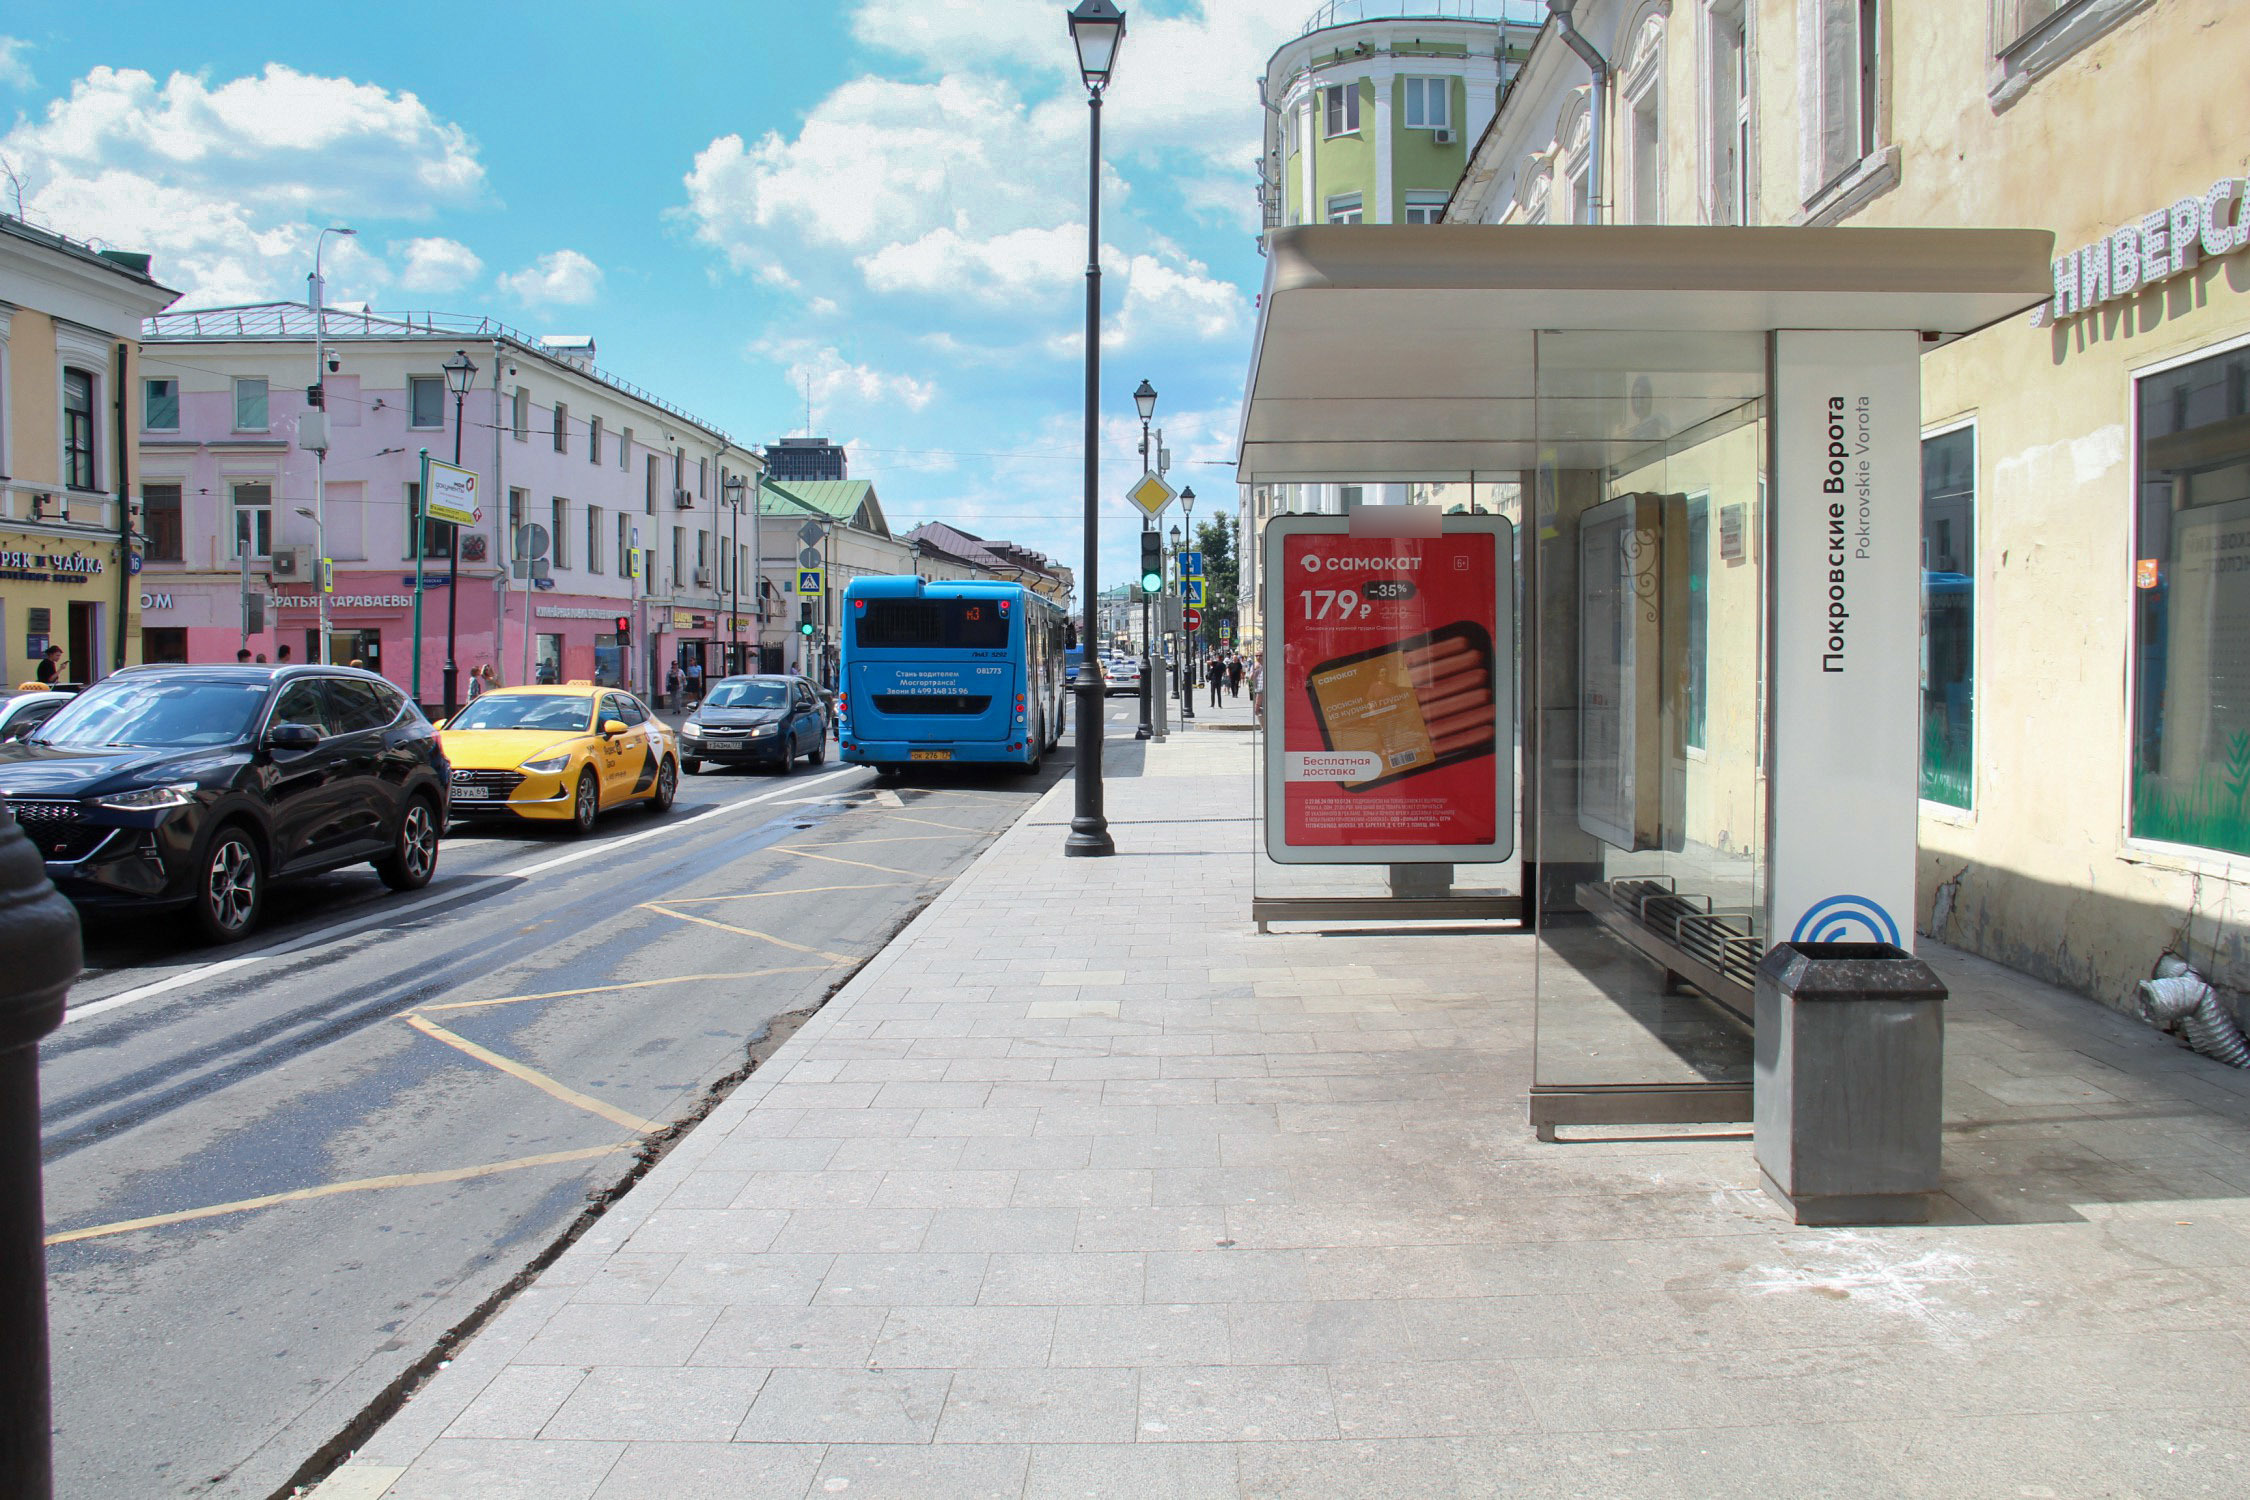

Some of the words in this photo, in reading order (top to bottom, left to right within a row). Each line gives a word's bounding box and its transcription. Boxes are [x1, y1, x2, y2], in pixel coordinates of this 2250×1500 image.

[2030, 170, 2250, 328] НИВЕРС
[1855, 396, 1871, 456] Vorota
[1822, 396, 1850, 494] Ворота
[1855, 460, 1871, 560] Pokrovskie
[53, 552, 104, 573] ЧАЙКА
[131, 557, 141, 570] 16
[1325, 557, 1422, 571] самокат
[1822, 503, 1850, 673] Покровские
[141, 593, 174, 609] ОМ
[896, 670, 918, 678] Стань
[976, 667, 1002, 675] 081773
[1317, 669, 1358, 686] самокат
[899, 679, 956, 687] Мосгортранса!
[1303, 756, 1371, 766] Бесплатная
[1302, 768, 1356, 777] доставка
